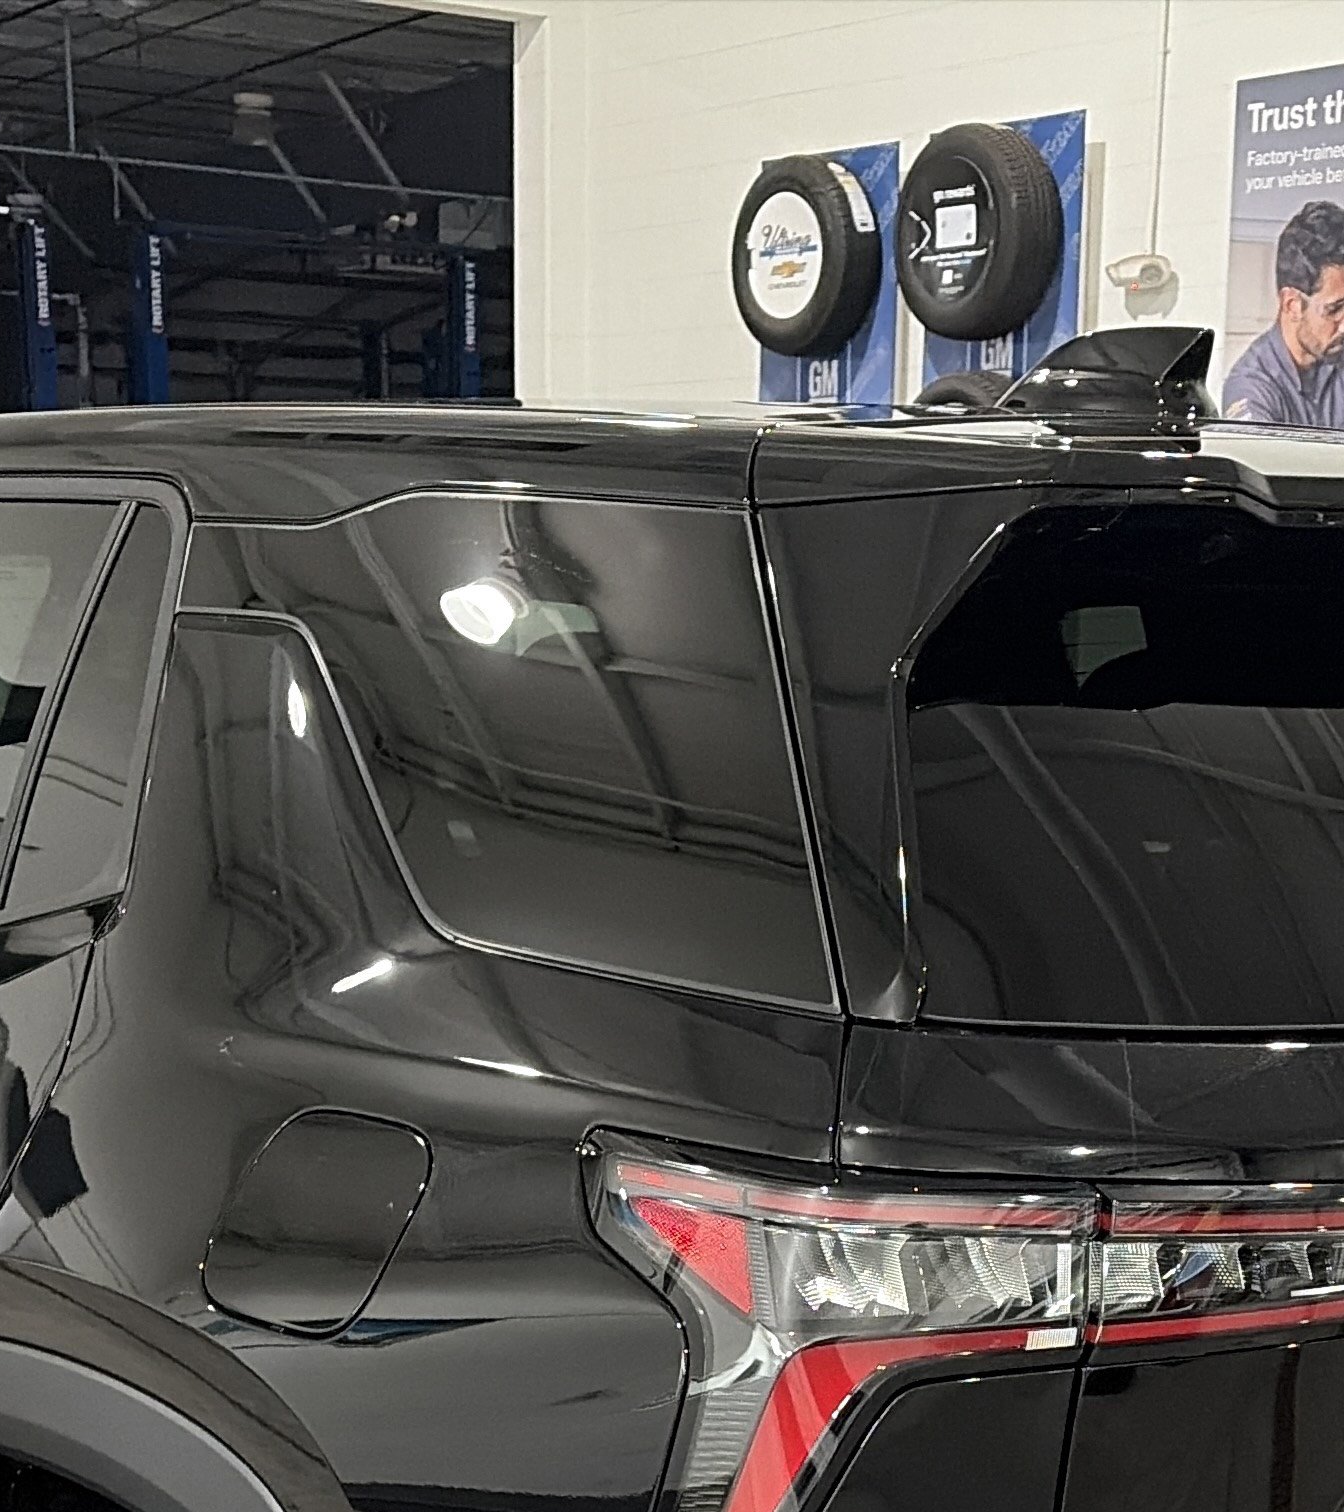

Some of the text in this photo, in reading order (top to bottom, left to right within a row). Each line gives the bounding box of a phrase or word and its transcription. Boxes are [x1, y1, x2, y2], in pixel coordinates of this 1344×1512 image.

[1247, 96, 1318, 133] Trust
[1245, 177, 1274, 194] your
[1278, 168, 1323, 187] vehicle
[981, 337, 1013, 370] GM
[809, 359, 839, 396] GM
